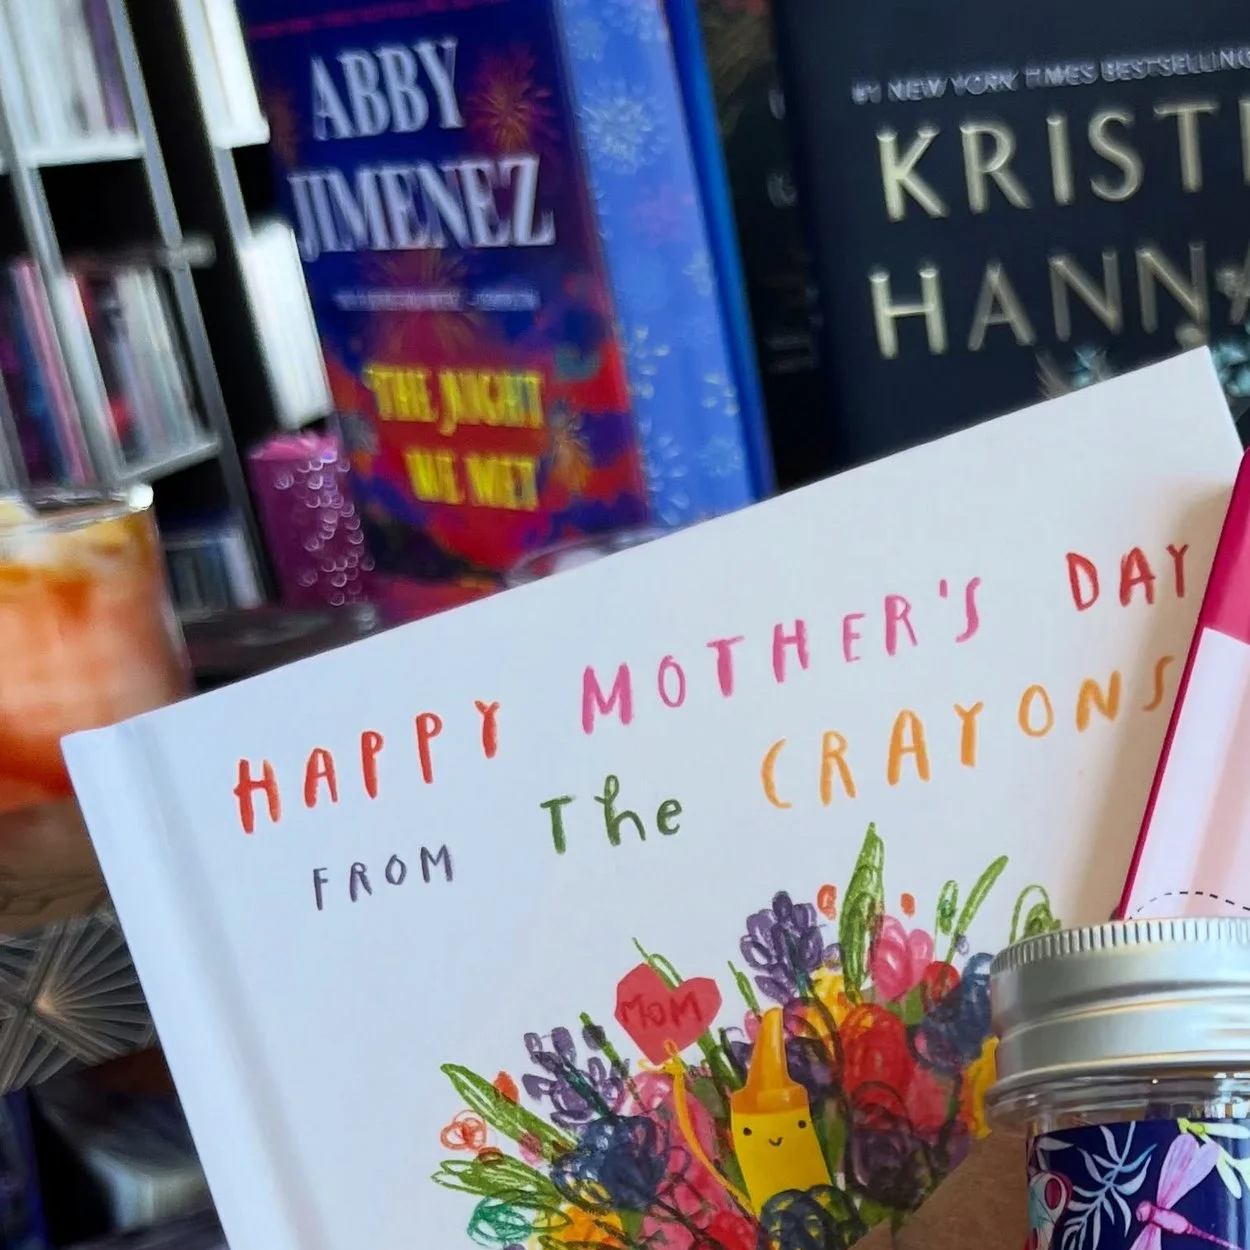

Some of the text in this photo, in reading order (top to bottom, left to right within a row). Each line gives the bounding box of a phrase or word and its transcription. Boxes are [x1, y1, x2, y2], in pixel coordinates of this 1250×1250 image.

[308, 37, 467, 142] ABBY
[888, 76, 947, 102] NEW
[949, 68, 1020, 97] YORK
[1024, 60, 1099, 89] TIMES
[287, 153, 556, 262] JIMENEZ
[234, 544, 1189, 833] HAPPY MOTHER'S DAY
[313, 655, 1175, 910] FROM The CRAYONS
[621, 991, 703, 1030] MOM
